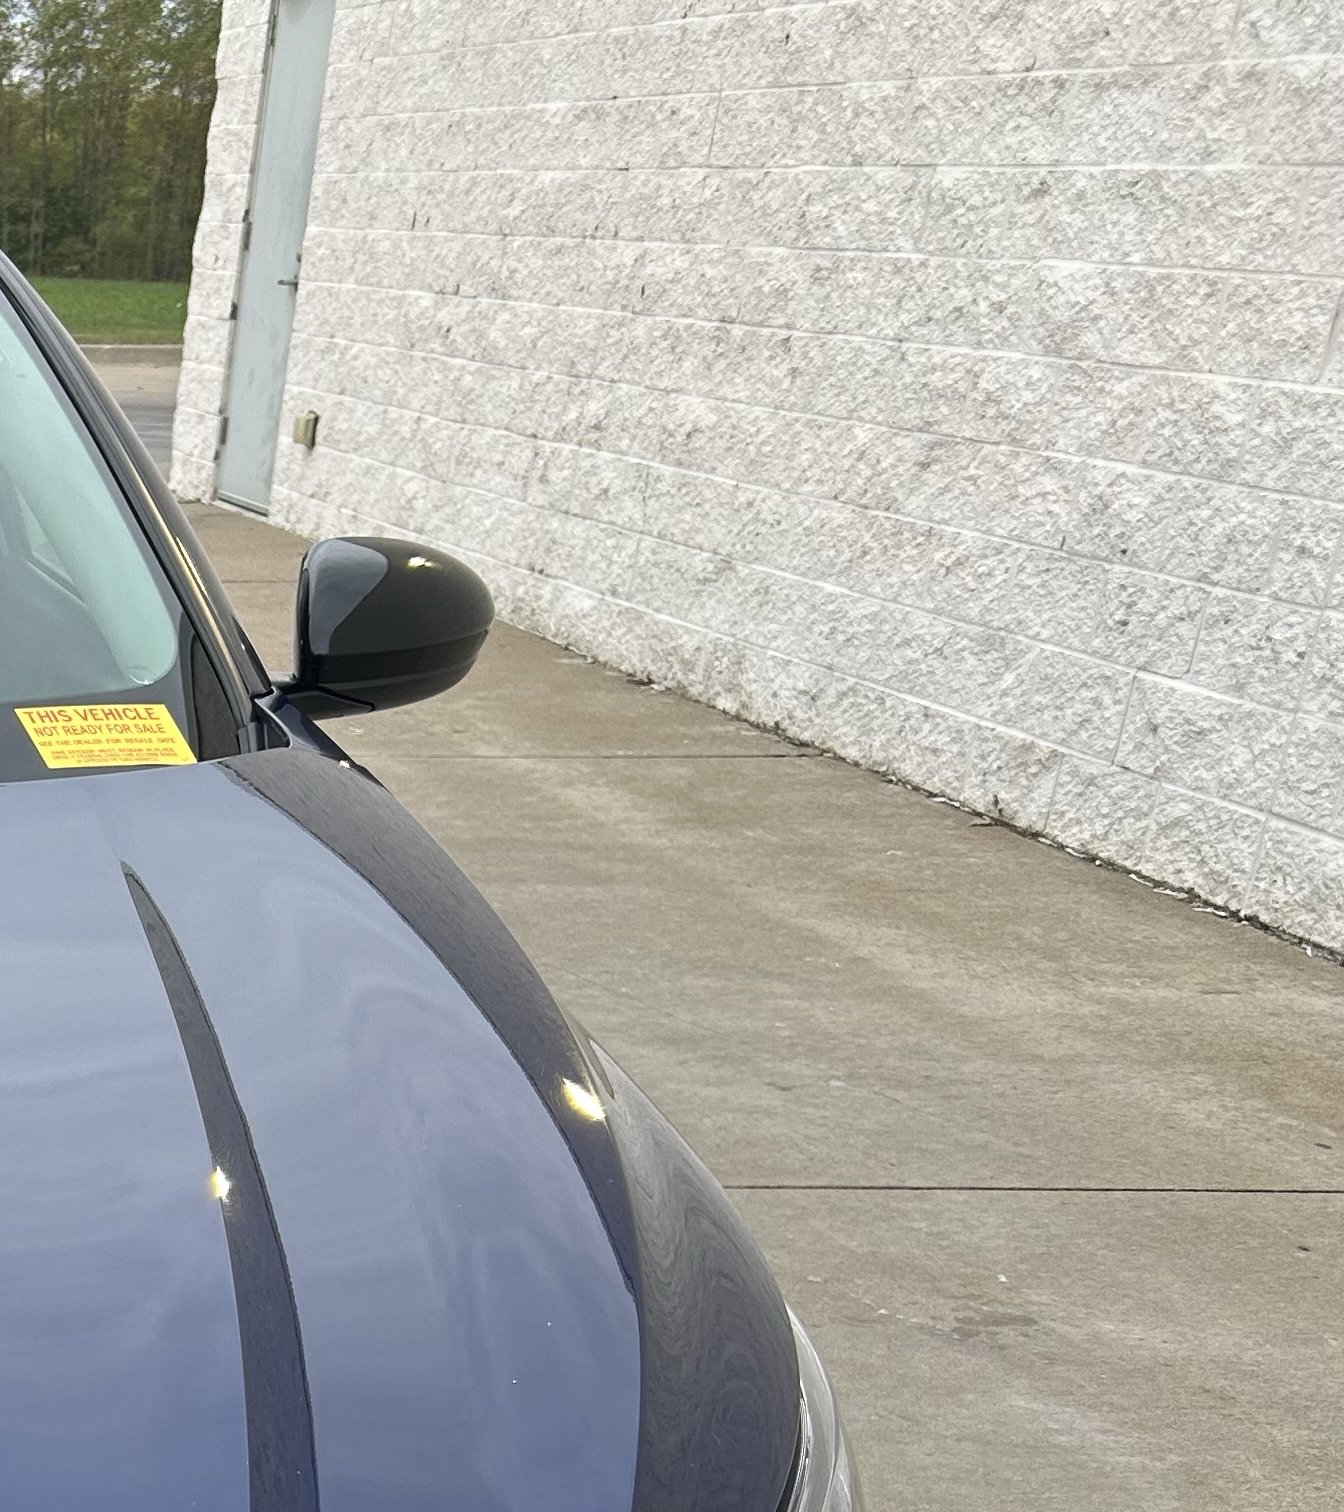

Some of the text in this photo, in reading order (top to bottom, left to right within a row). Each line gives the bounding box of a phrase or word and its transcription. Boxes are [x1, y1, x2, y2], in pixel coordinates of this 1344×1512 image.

[22, 707, 161, 724] THIS VEHICLE
[33, 723, 167, 737] NOT READY FOR SALE
